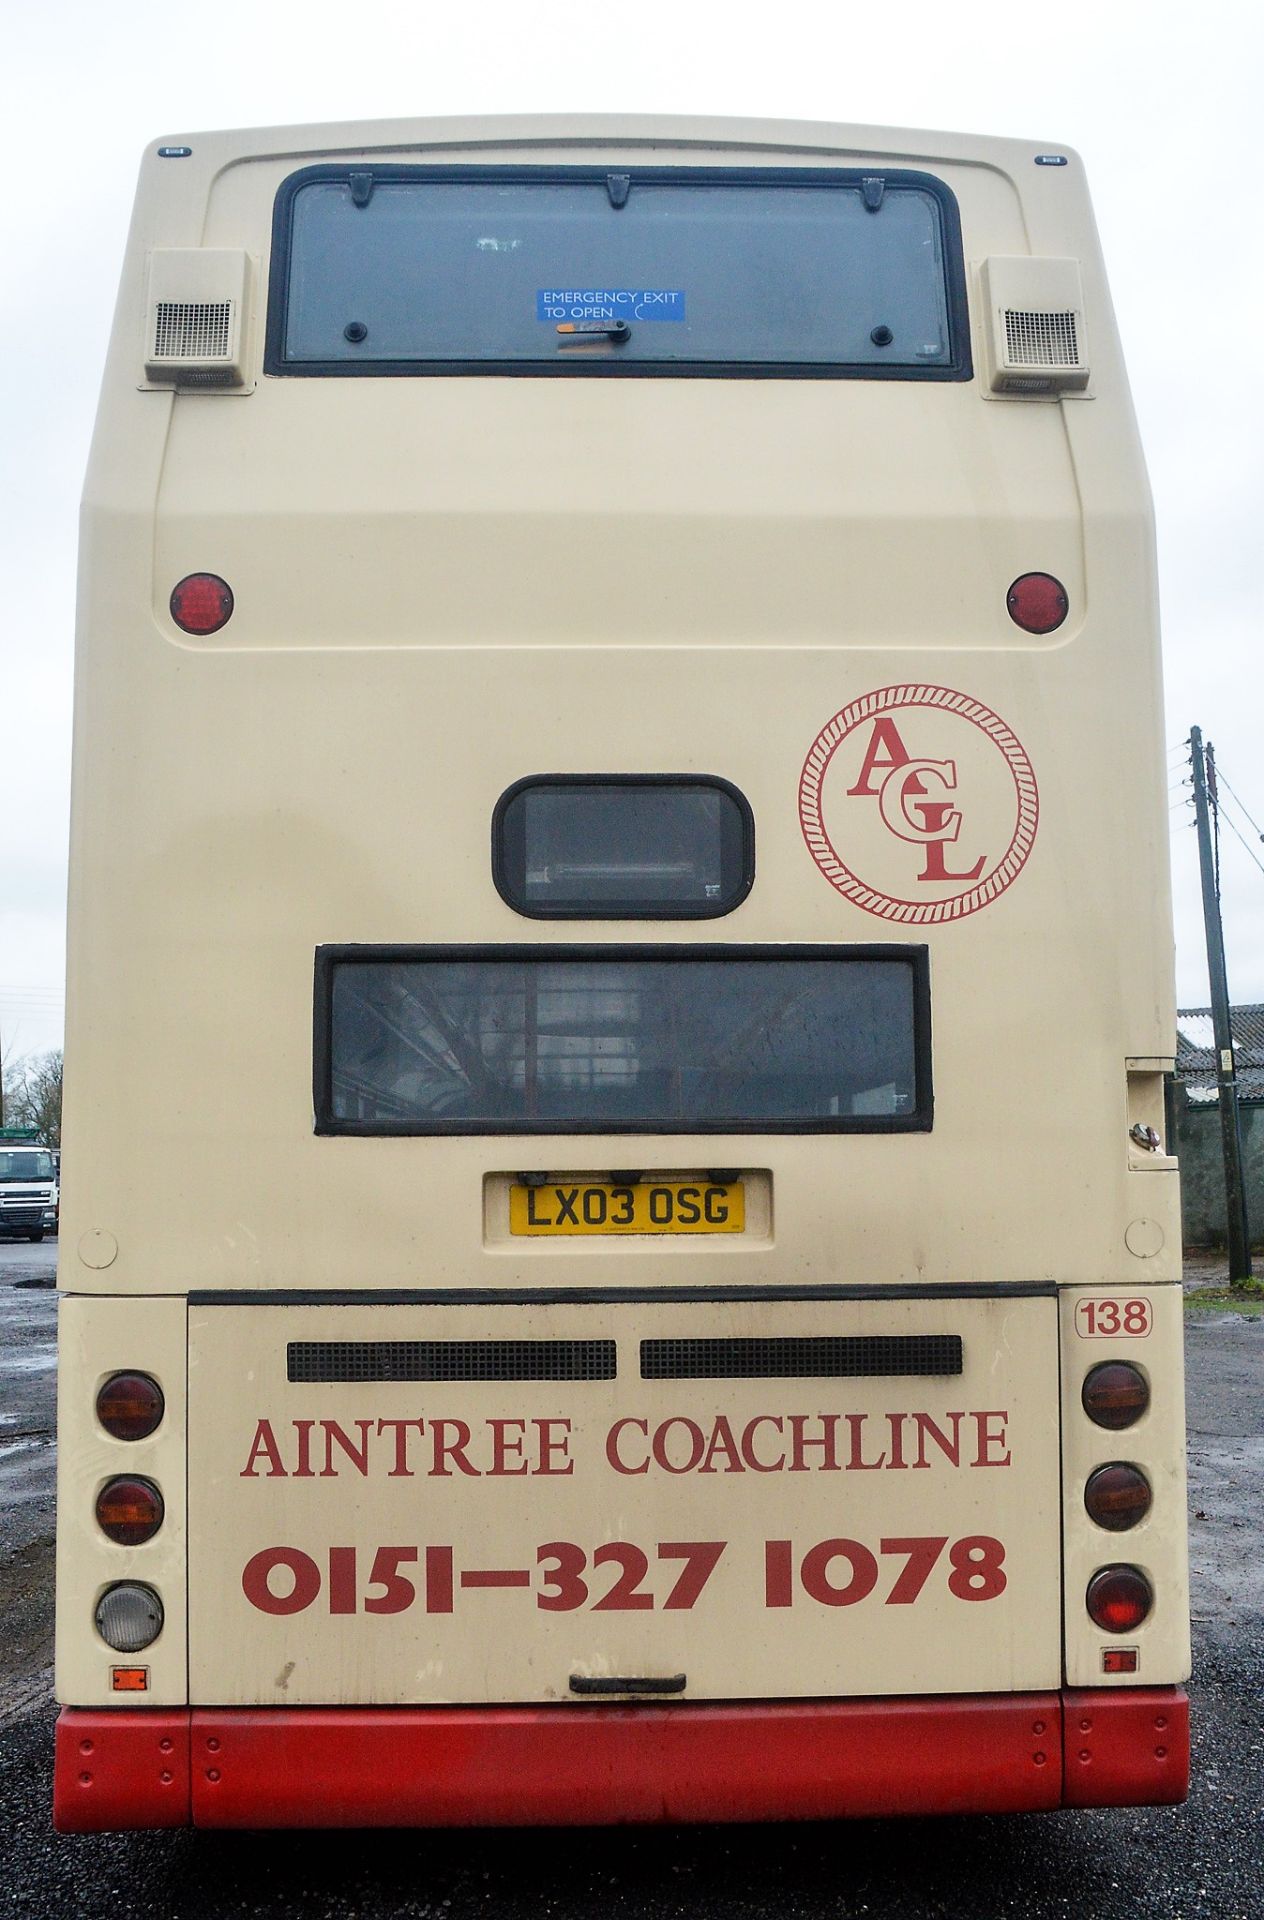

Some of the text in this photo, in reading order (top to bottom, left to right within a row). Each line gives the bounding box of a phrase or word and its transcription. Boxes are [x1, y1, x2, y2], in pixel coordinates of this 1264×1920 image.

[543, 292, 679, 303] EMERGENCY EXIT
[544, 306, 613, 318] TO OPEN
[527, 1187, 729, 1226] LX03 OSG
[1080, 1301, 1148, 1335] 138
[239, 1410, 1012, 1478] AINTREE COACHLINE
[765, 1535, 1008, 1608] 1078
